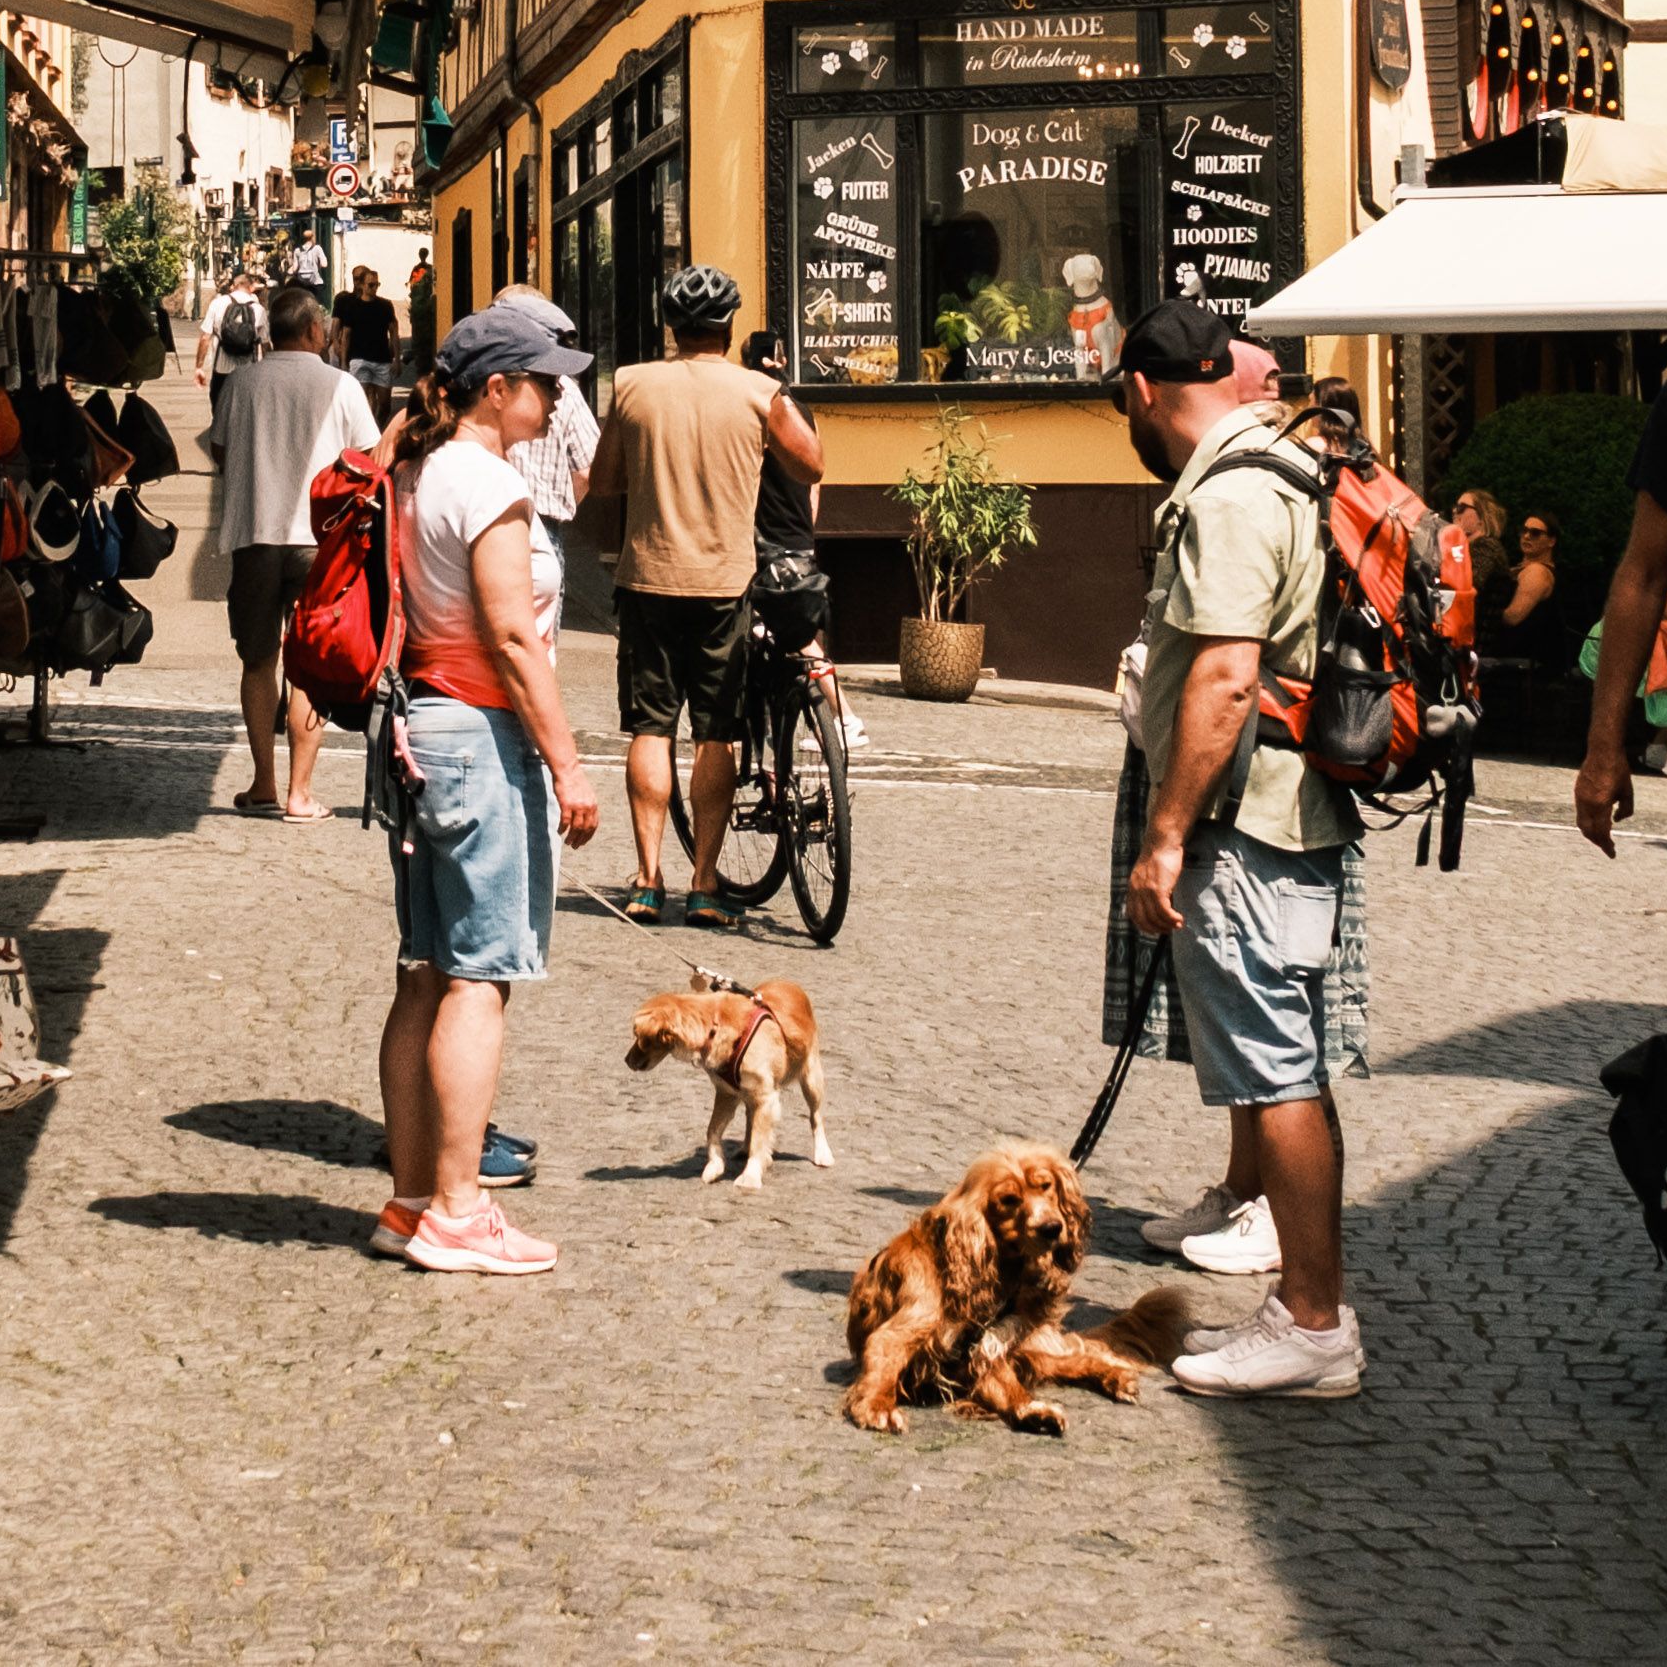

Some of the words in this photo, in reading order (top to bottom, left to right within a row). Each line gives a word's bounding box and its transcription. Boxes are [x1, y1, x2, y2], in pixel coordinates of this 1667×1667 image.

[956, 19, 1026, 42] HAND
[1034, 15, 1104, 38] MADE
[965, 55, 984, 71] in
[972, 123, 1021, 151] Dog
[1026, 124, 1040, 143] &
[1044, 118, 1083, 143] Cat
[1210, 115, 1272, 148] Decken
[806, 136, 857, 174] Jacken
[1195, 154, 1263, 174] HOLZBETT
[956, 156, 1108, 193] PARADISE
[842, 181, 889, 201] FUTTER
[1171, 180, 1271, 217] SCHLAFSÄCKE
[826, 212, 879, 238] GRÜNE
[1173, 227, 1258, 246] HOODIES
[813, 224, 897, 260] APOTHEKE
[805, 260, 865, 279] NÄPFE
[1204, 253, 1271, 283] PYJAMAS
[830, 302, 892, 324] T-SHIRTS
[966, 346, 1019, 370] Mary
[1023, 347, 1036, 365] &
[1040, 346, 1100, 369] Jessie
